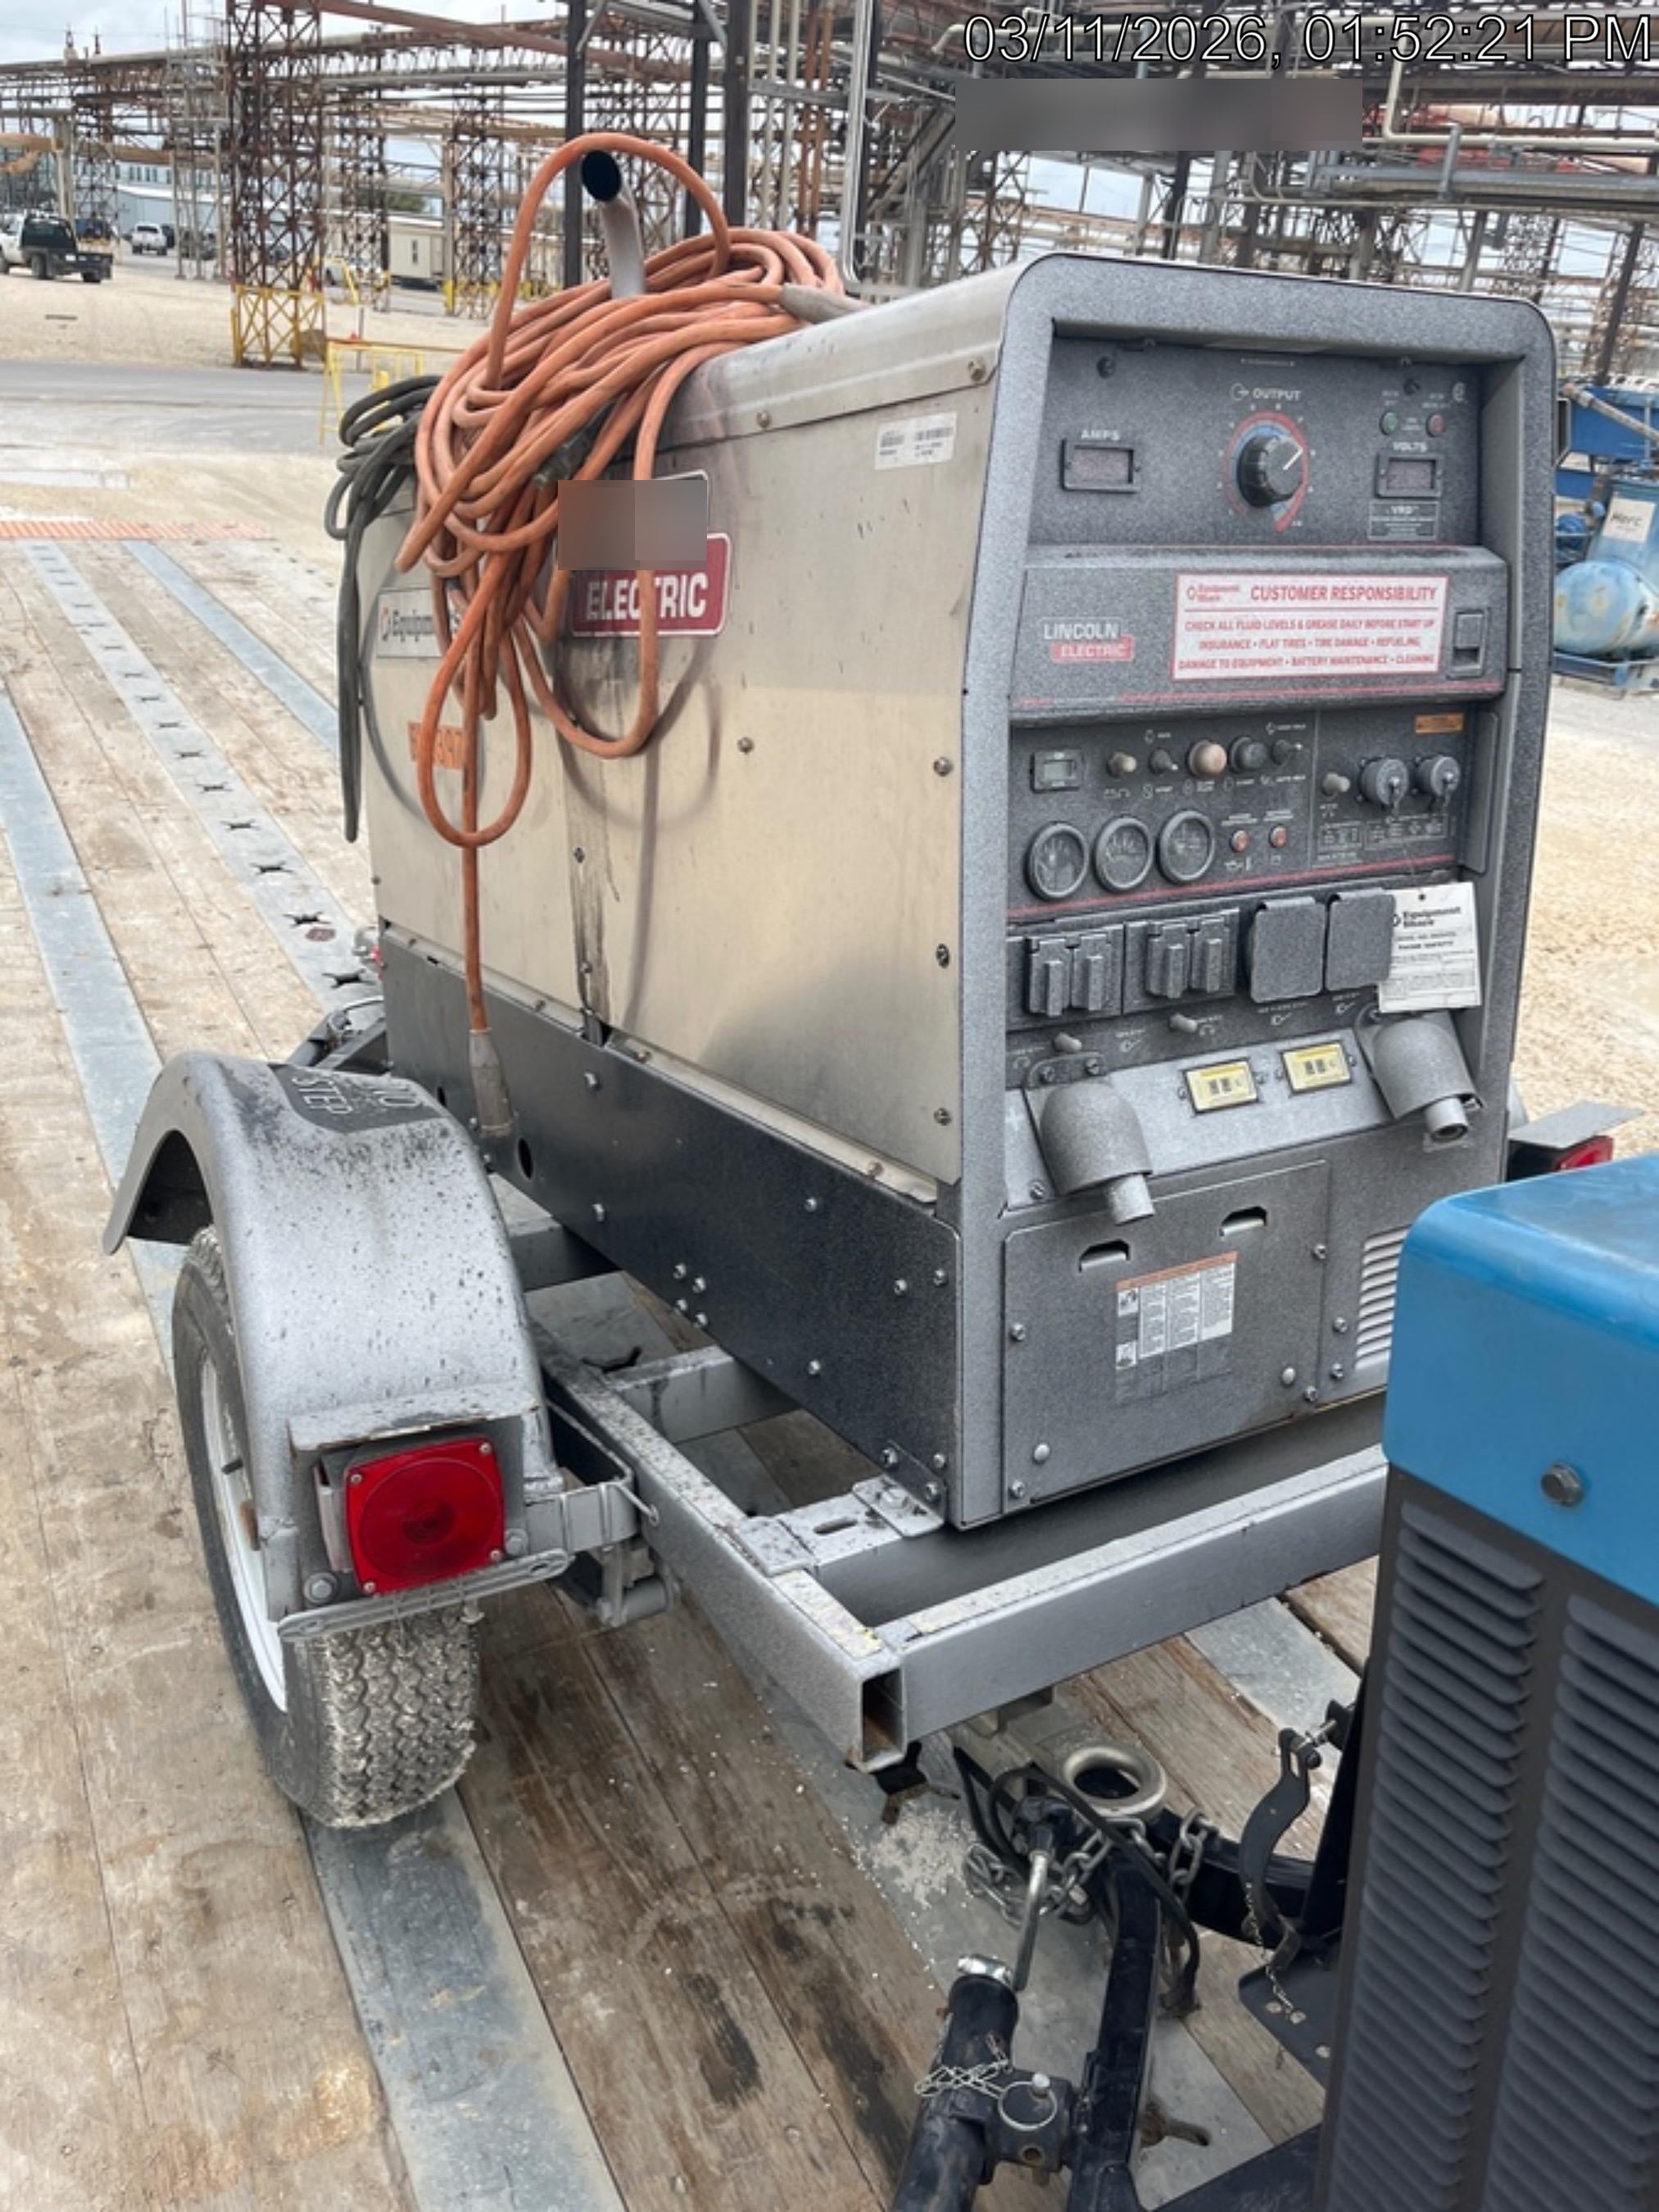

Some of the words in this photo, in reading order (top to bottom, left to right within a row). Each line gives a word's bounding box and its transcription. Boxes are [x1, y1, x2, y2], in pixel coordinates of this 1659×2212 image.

[1253, 388, 1301, 401] OUTPUT
[1081, 428, 1120, 441] AMPS
[587, 573, 708, 620] ELECRIC
[1251, 585, 1328, 601] CUSTOMER
[1330, 586, 1438, 601] RESPONSIBILITY
[393, 609, 433, 642] Equipm
[1044, 623, 1118, 639] LINCOLN
[1185, 620, 1214, 631] CHECK
[1218, 620, 1233, 630] ALL
[1236, 619, 1262, 630] FLUID
[1263, 619, 1295, 630] LEVELS
[1305, 619, 1337, 629] GREASE
[1339, 619, 1362, 629] DAILY
[1364, 619, 1394, 629] BEFORE
[1199, 639, 1251, 650] INSURANCE
[1258, 638, 1279, 649] FLAT
[1335, 637, 1368, 647] DAMAGE
[1179, 659, 1217, 669] DAMAGE
[1232, 657, 1283, 668] EQUIPMENT
[1292, 656, 1327, 666] BATTERY
[1330, 656, 1388, 665] MAINTENANCE
[292, 1075, 354, 1115] STEP
